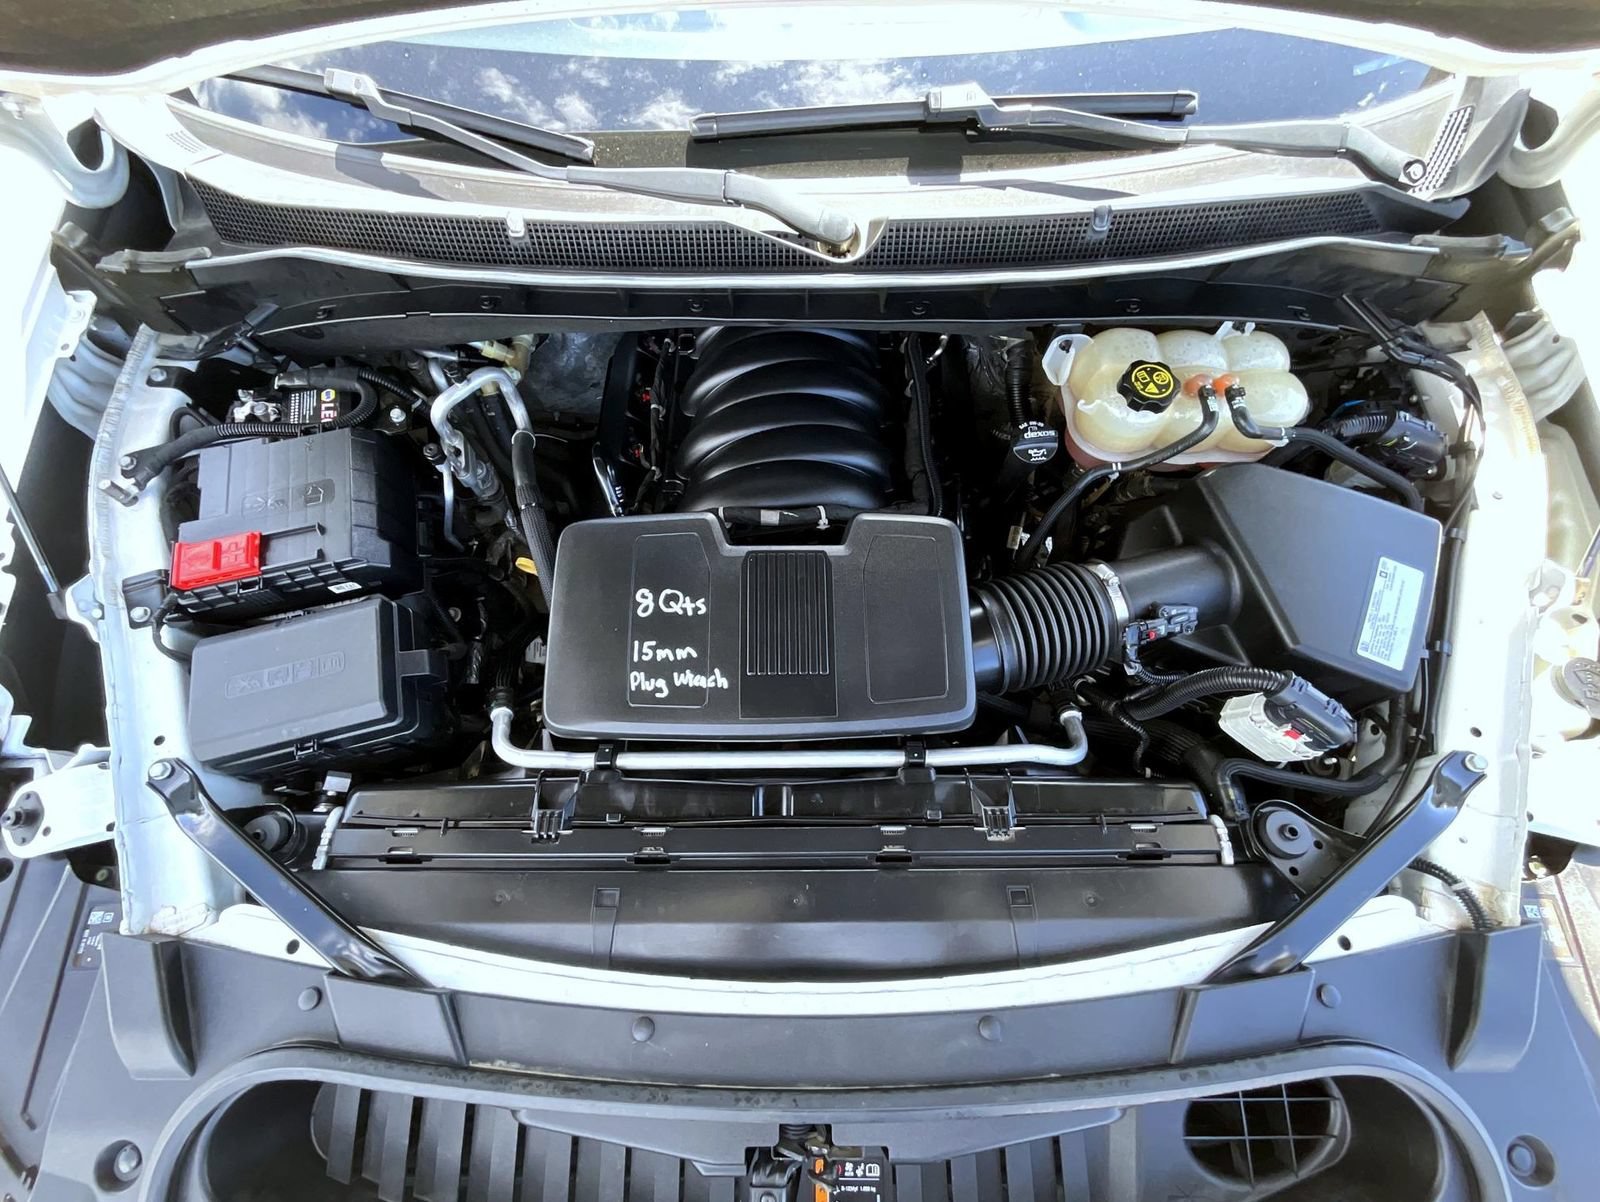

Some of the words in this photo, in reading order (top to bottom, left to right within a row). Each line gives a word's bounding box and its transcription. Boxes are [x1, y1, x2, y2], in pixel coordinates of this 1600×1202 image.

[635, 588, 655, 618] 8
[658, 588, 707, 617] Qts
[633, 639, 698, 663] 15mm
[630, 670, 669, 698] Plug
